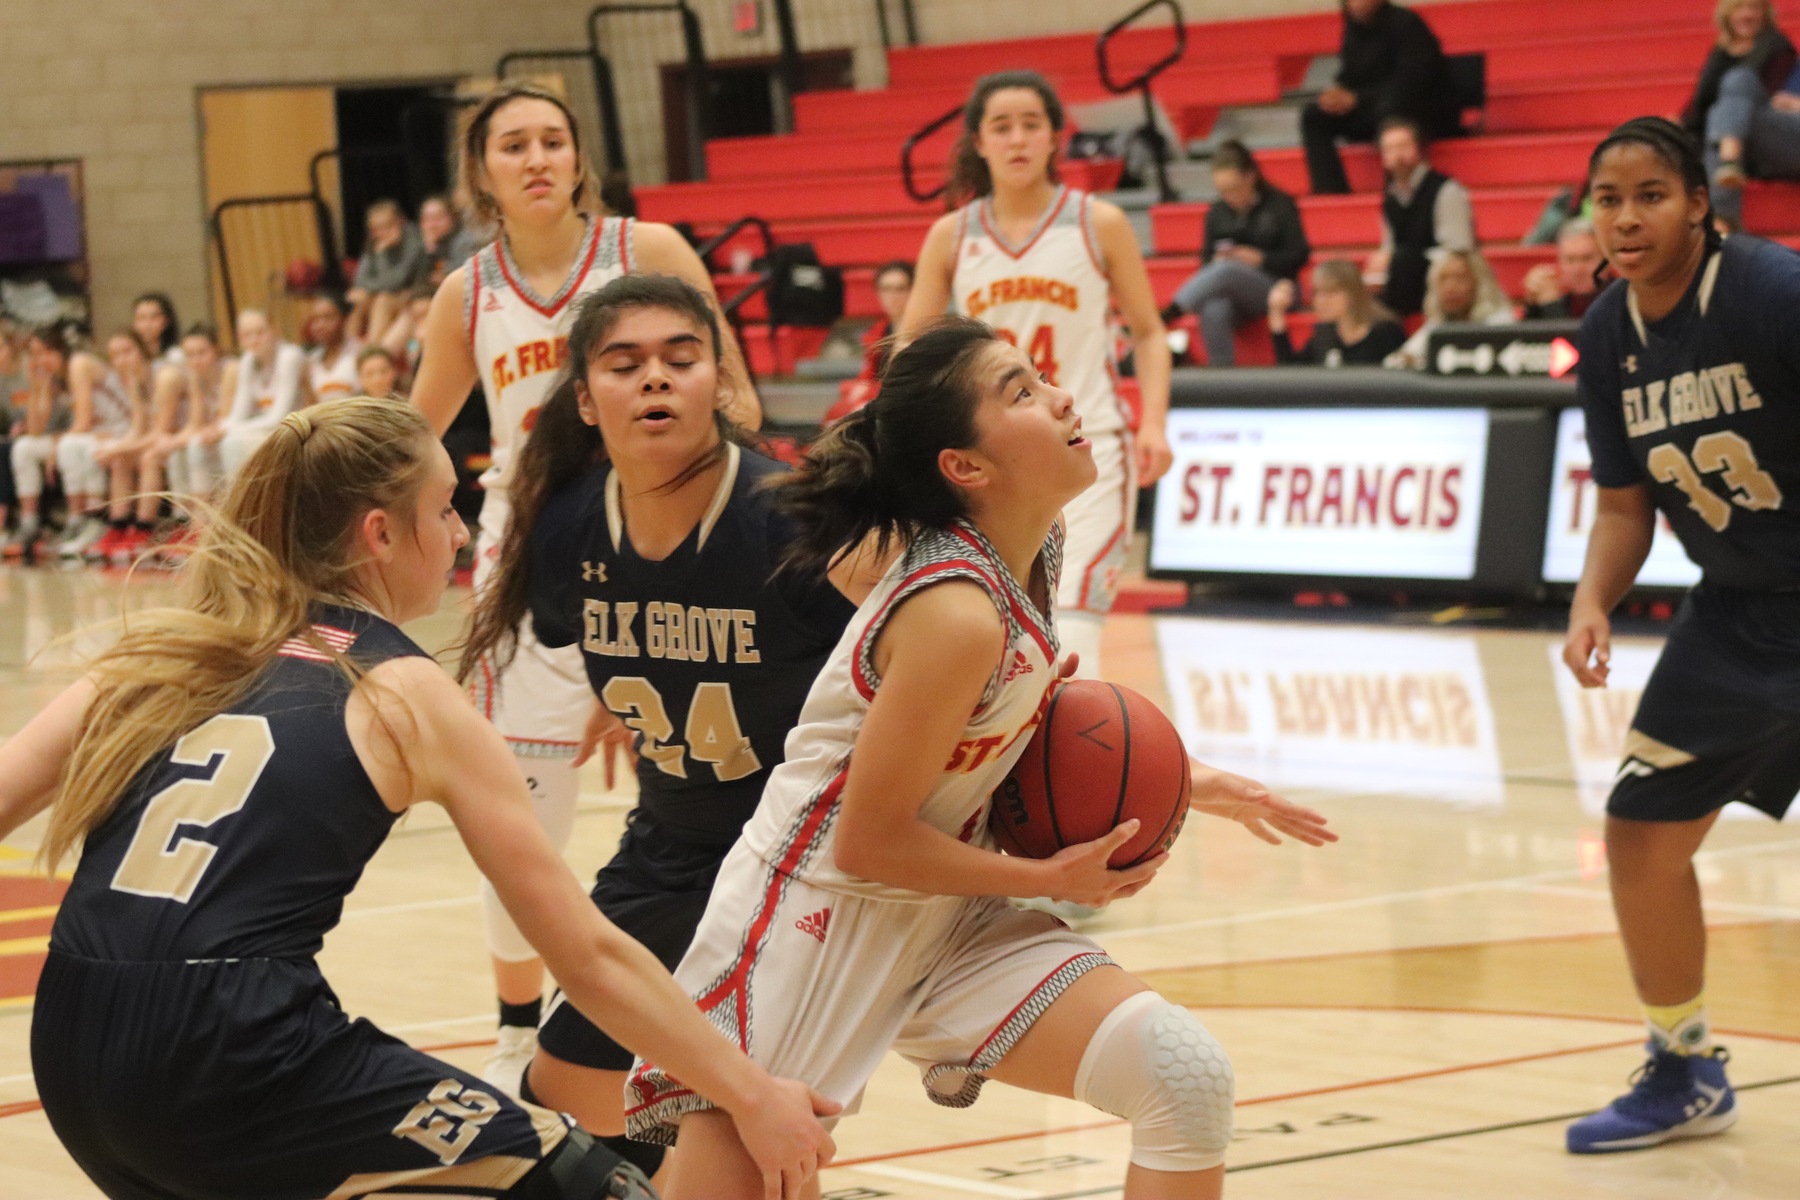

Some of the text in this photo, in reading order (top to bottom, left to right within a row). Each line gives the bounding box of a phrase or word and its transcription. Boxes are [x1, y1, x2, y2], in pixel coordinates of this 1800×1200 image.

[1621, 362, 1762, 438] ELK GROVE
[1178, 463, 1463, 530] ST. FRANCIS
[583, 598, 761, 663] ELK GROVE
[601, 676, 763, 781] 24
[110, 713, 276, 904] 2
[391, 1078, 502, 1167] EG
